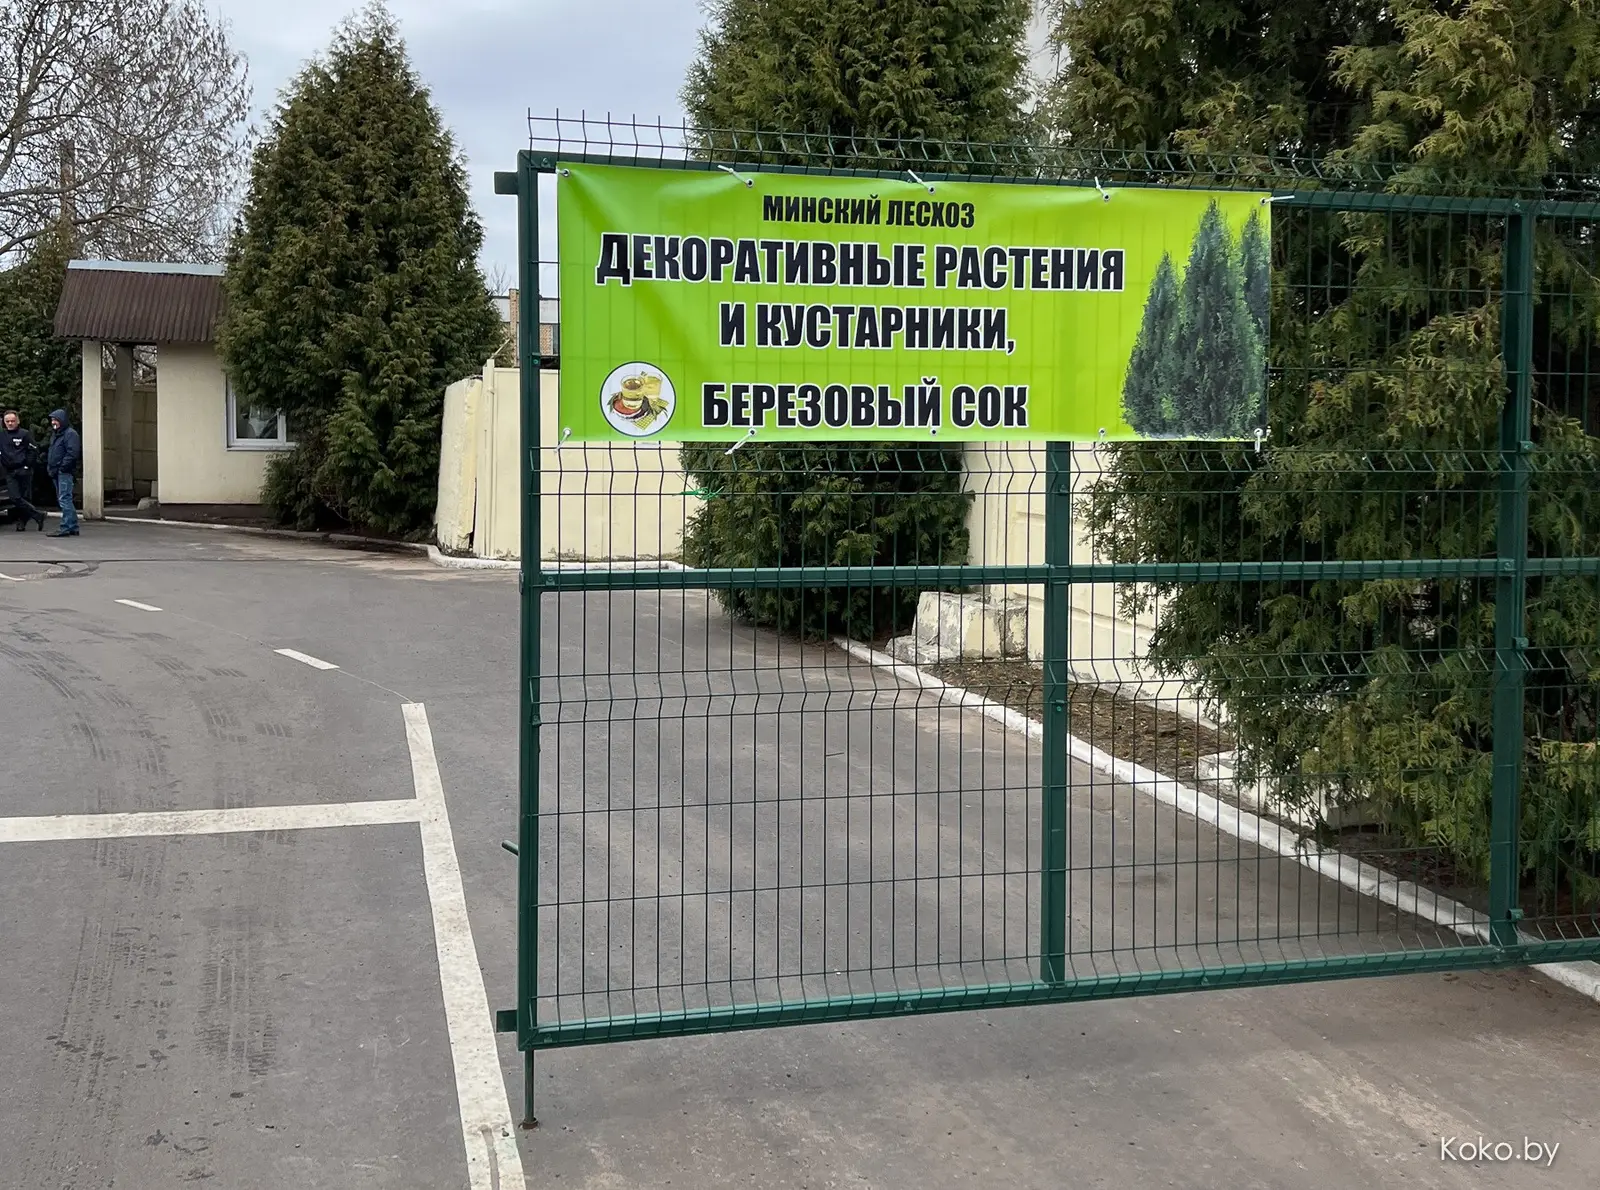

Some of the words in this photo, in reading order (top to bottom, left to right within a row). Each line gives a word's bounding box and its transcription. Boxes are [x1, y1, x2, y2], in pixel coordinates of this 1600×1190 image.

[763, 194, 881, 226] МИНСКИЙ
[886, 201, 975, 228] ЛЕСХОЗ
[596, 232, 925, 288] ДЕКОРАТИВНЫЕ
[934, 246, 1124, 291] РАСТЕНИЯ
[720, 303, 746, 348] И
[756, 304, 1015, 355] КУСТАРНИКИ,
[702, 377, 943, 429] БЕРЕЗОВЫЙ
[951, 386, 1028, 429] СОК
